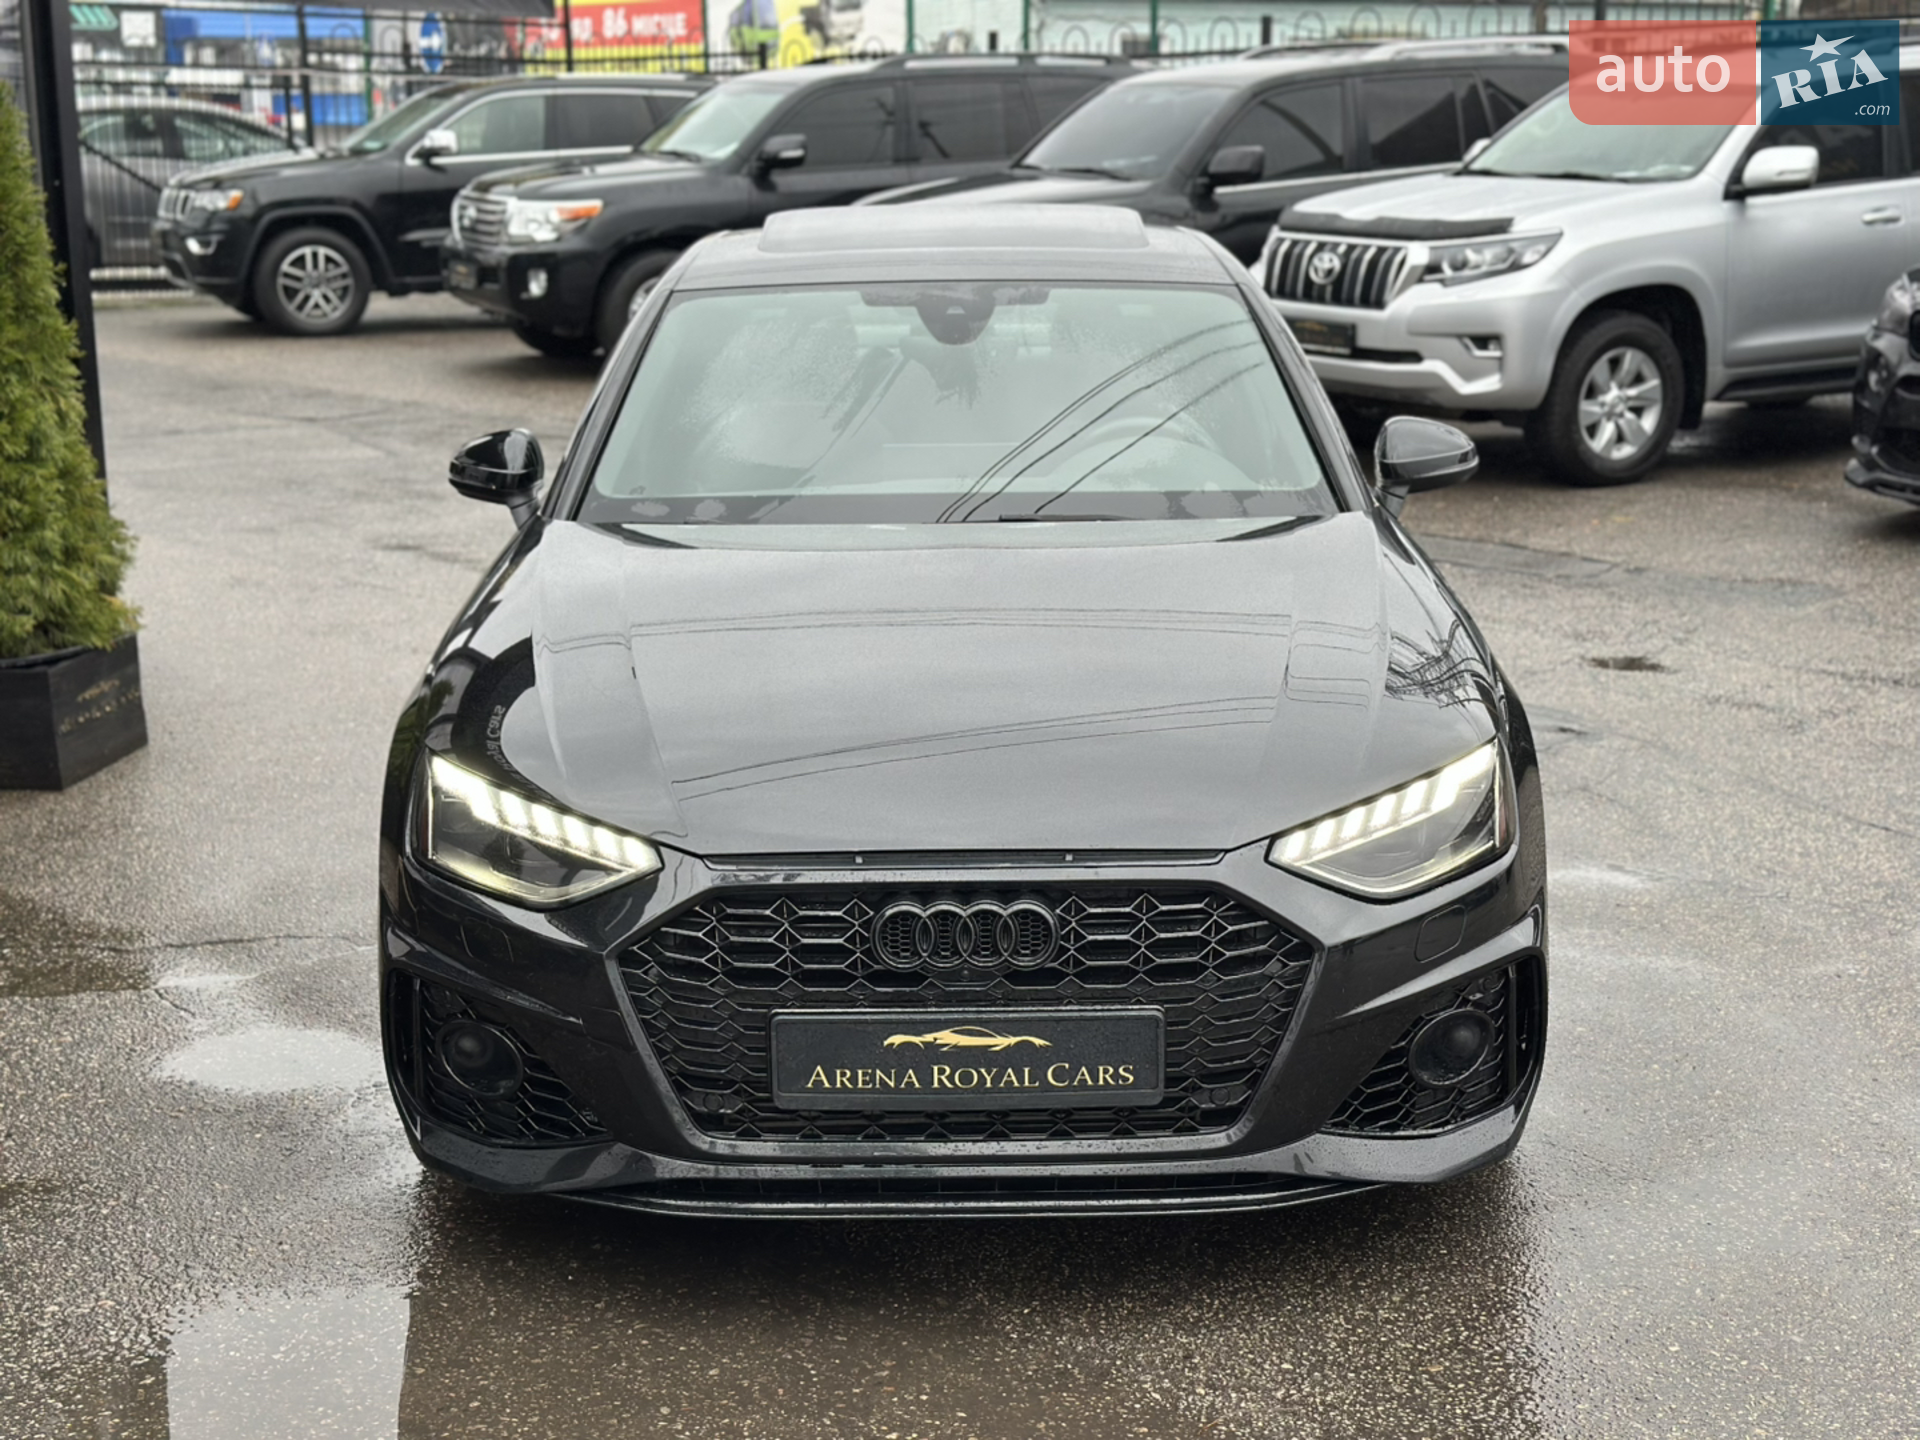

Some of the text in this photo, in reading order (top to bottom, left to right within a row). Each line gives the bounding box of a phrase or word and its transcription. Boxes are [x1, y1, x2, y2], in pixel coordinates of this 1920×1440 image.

[602, 7, 628, 39] 86
[631, 13, 687, 38] МІСЦЕ
[805, 1062, 1135, 1089] ARENA ROYAL CARS
